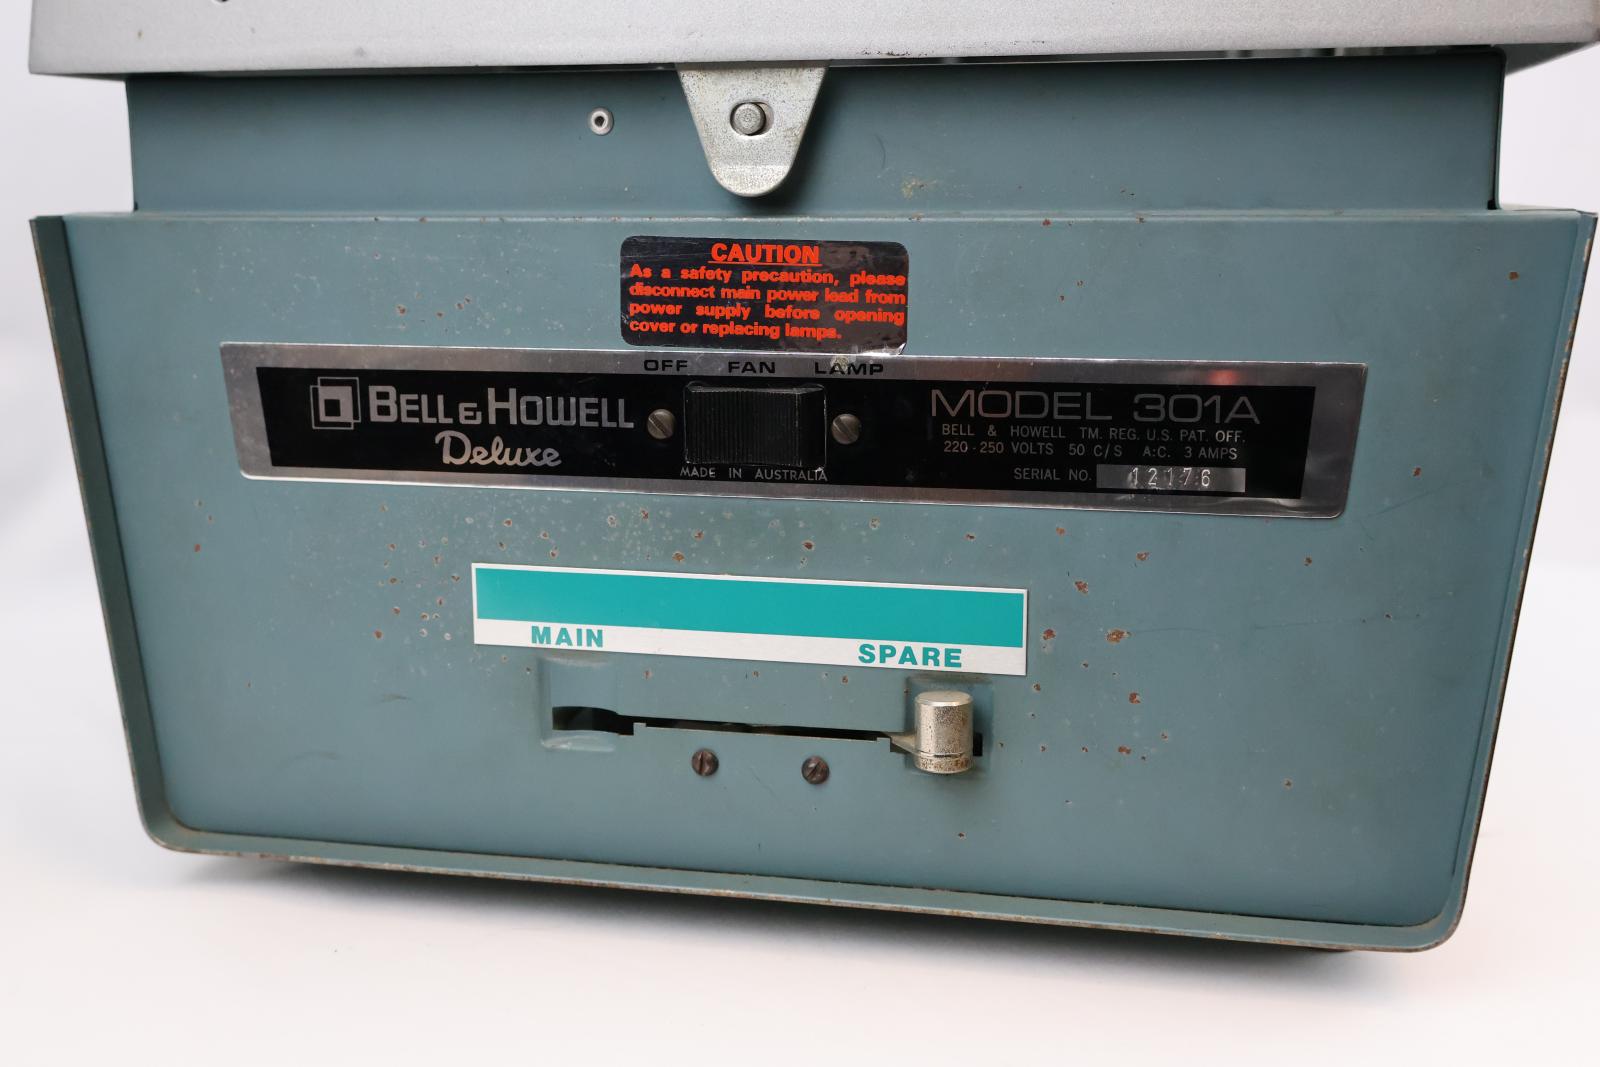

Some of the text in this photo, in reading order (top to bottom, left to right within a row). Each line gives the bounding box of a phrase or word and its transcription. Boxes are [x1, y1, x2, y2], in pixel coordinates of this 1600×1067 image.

[711, 243, 819, 263] CAUTION
[629, 263, 906, 286] As a safety precaution, please
[629, 283, 906, 305] disconnect main power lead from
[629, 302, 905, 326] power supply before opening
[629, 321, 842, 340] cover or replacing lamps.
[644, 359, 688, 371] OFF
[728, 362, 776, 374] FAN
[815, 363, 884, 376] LAMP
[458, 402, 482, 425] &
[931, 390, 1261, 424] MODEL 301A
[942, 424, 975, 436] BELL
[987, 425, 997, 437] &
[1010, 426, 1066, 438] HOWELL
[1110, 428, 1139, 441] REG.
[1146, 430, 1173, 441] U.S.
[1180, 430, 1206, 442] PAT.
[1215, 431, 1246, 443] OFF.
[435, 430, 562, 466] Deluxe
[1012, 442, 1054, 455] VOLTS
[1068, 444, 1085, 456] 50
[1094, 445, 1122, 457] C/S
[1184, 447, 1192, 459] 3
[1198, 447, 1238, 460] AMPS
[680, 467, 828, 482] MADE IN AUSTRALIA
[1014, 468, 1061, 481] SERIAL
[1068, 469, 1092, 482] NO.
[531, 625, 604, 649] MAIN
[858, 643, 962, 669] SPARE
